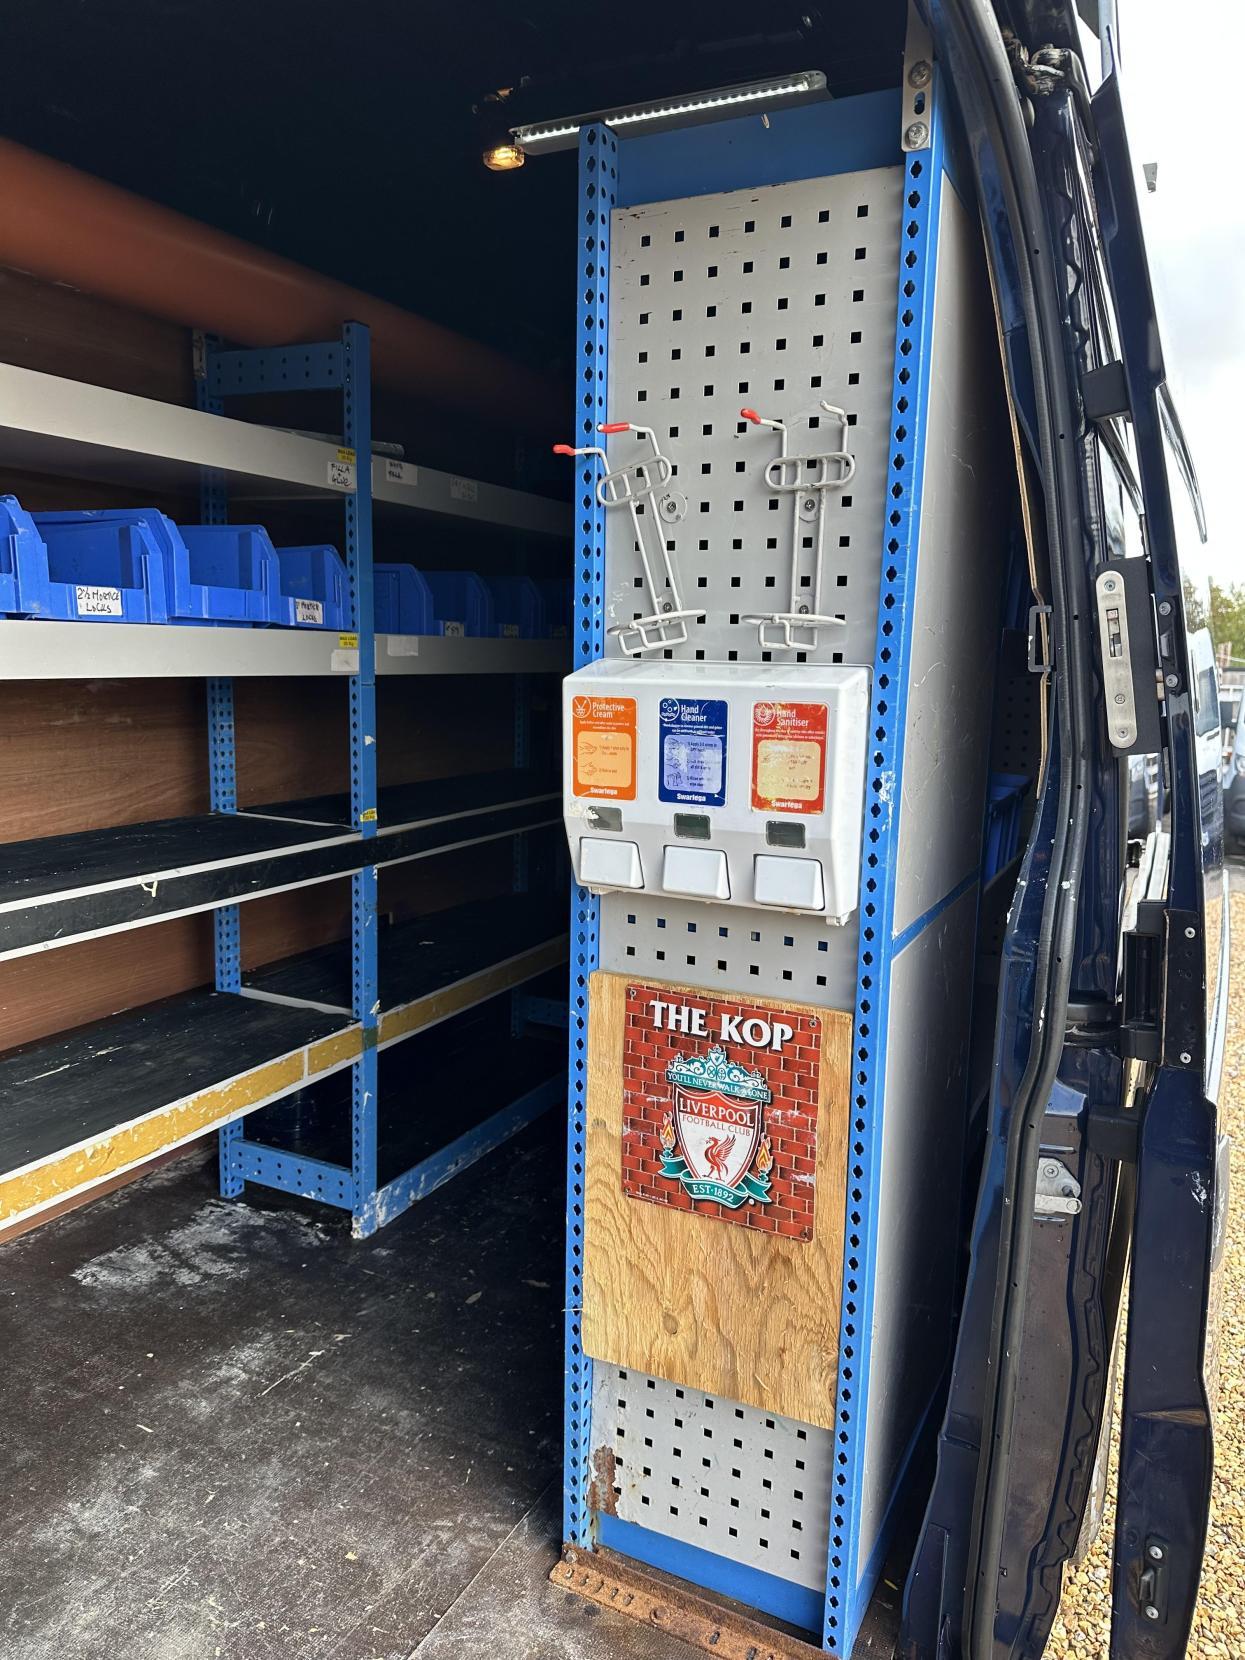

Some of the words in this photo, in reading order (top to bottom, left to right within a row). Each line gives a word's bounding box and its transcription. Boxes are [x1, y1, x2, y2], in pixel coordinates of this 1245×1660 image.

[592, 702, 625, 712] Protective
[681, 705, 699, 714] Hand
[592, 710, 613, 718] Cream
[681, 713, 707, 722] Cleaner
[776, 709, 796, 718] Hand
[777, 718, 809, 727] Sanitiser
[590, 787, 618, 795] Swarfega
[677, 793, 706, 802] Swarfega
[771, 800, 802, 809] Swarfega
[649, 1000, 708, 1037] THE
[720, 1013, 793, 1051] KOP
[668, 1072, 691, 1084] YOU'LL
[692, 1078, 718, 1089] NEVER
[718, 1082, 741, 1094] WALK
[741, 1087, 768, 1100] ALONE
[679, 1097, 754, 1127] LIVERPOOL
[682, 1114, 726, 1132] FOOTBALL
[727, 1125, 751, 1137] CLUB
